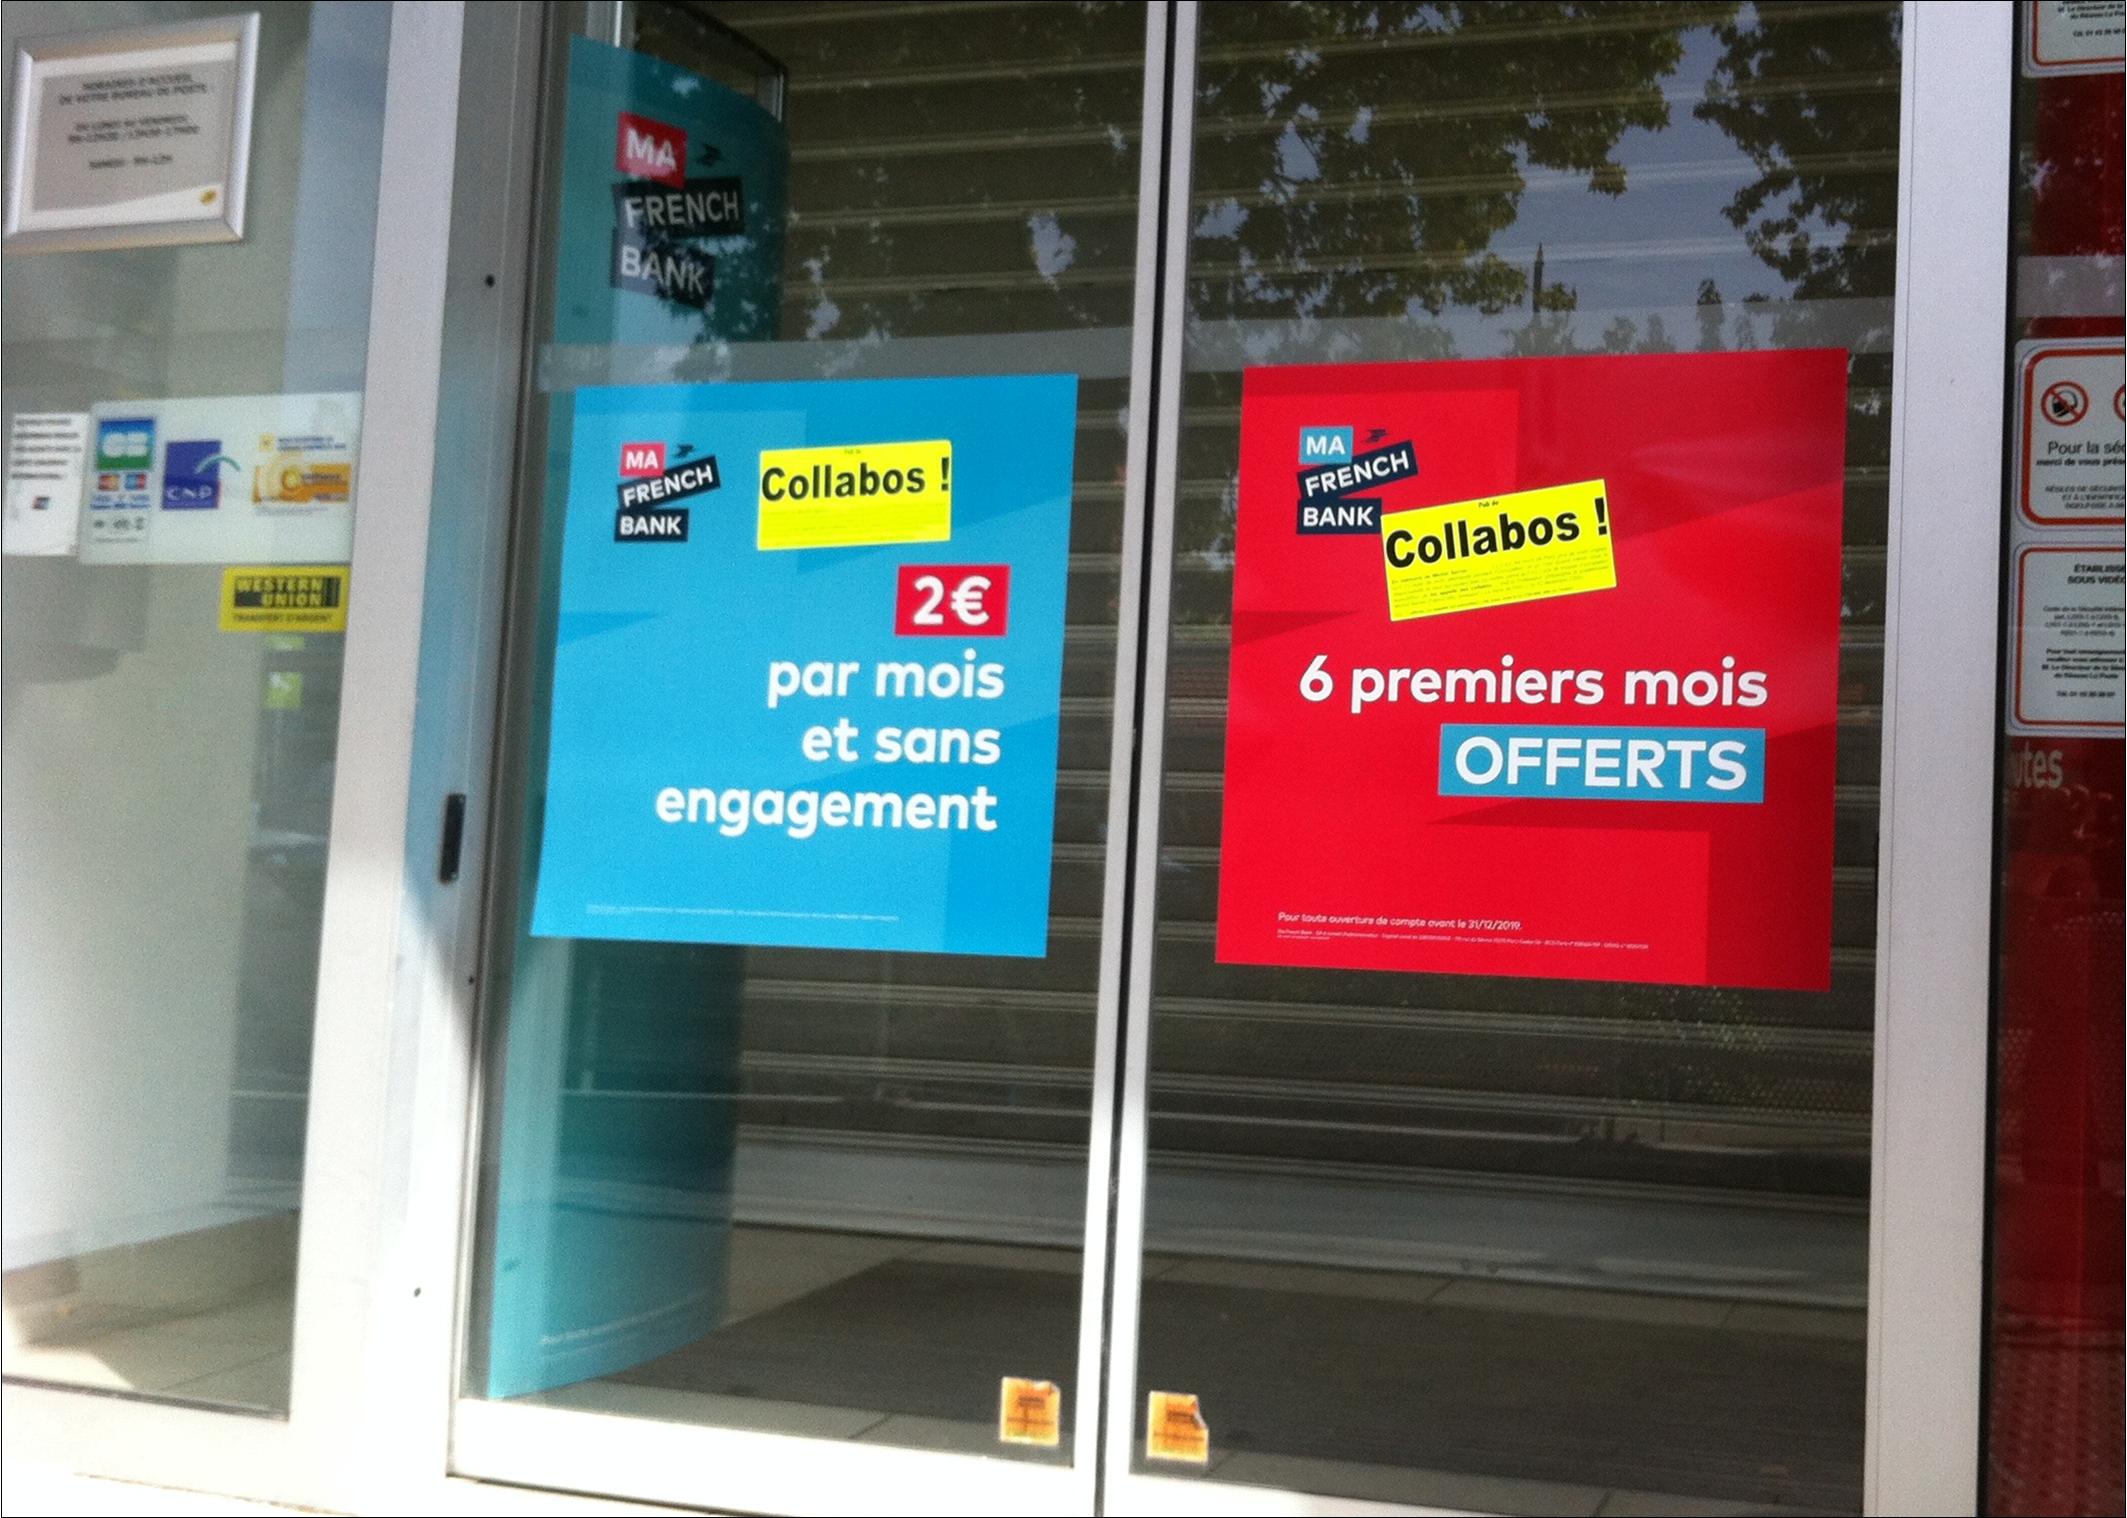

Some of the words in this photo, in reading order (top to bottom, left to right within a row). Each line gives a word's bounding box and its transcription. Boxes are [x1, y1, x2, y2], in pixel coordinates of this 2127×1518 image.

[626, 127, 678, 172] MA
[623, 189, 740, 229] FRENCH
[620, 244, 706, 294] BANK
[625, 450, 659, 470] MA
[1305, 435, 1346, 456] MA
[2048, 441, 2082, 454] Pour
[2086, 441, 2099, 454] la
[622, 464, 714, 508] FRENCH
[761, 461, 926, 501] Collabos
[940, 457, 951, 491] !
[1304, 450, 1411, 497] FRENCH
[619, 515, 682, 536] BANK
[1302, 505, 1374, 527] BANK
[1385, 512, 1580, 569] Collabos
[1594, 497, 1608, 536] !
[235, 577, 322, 592] WESTERN
[261, 592, 322, 608] UNION
[912, 574, 992, 627] 2€
[2067, 575, 2095, 584] SOUS
[767, 660, 860, 709] par
[875, 647, 1005, 699] mois
[1299, 654, 1334, 702] 6
[1350, 654, 1605, 715] premiers
[1624, 655, 1769, 708] mois
[802, 717, 860, 762] et
[874, 725, 1002, 765] sans
[1454, 735, 1749, 791] OFFERTS
[655, 785, 998, 840] engagement
[1277, 911, 1301, 922] Pour
[1302, 913, 1327, 923] toute
[1328, 915, 1374, 926] ouverture
[1375, 915, 1388, 926] de
[1389, 917, 1427, 929] compte
[1428, 919, 1456, 929] avant
[1457, 919, 1466, 929] le
